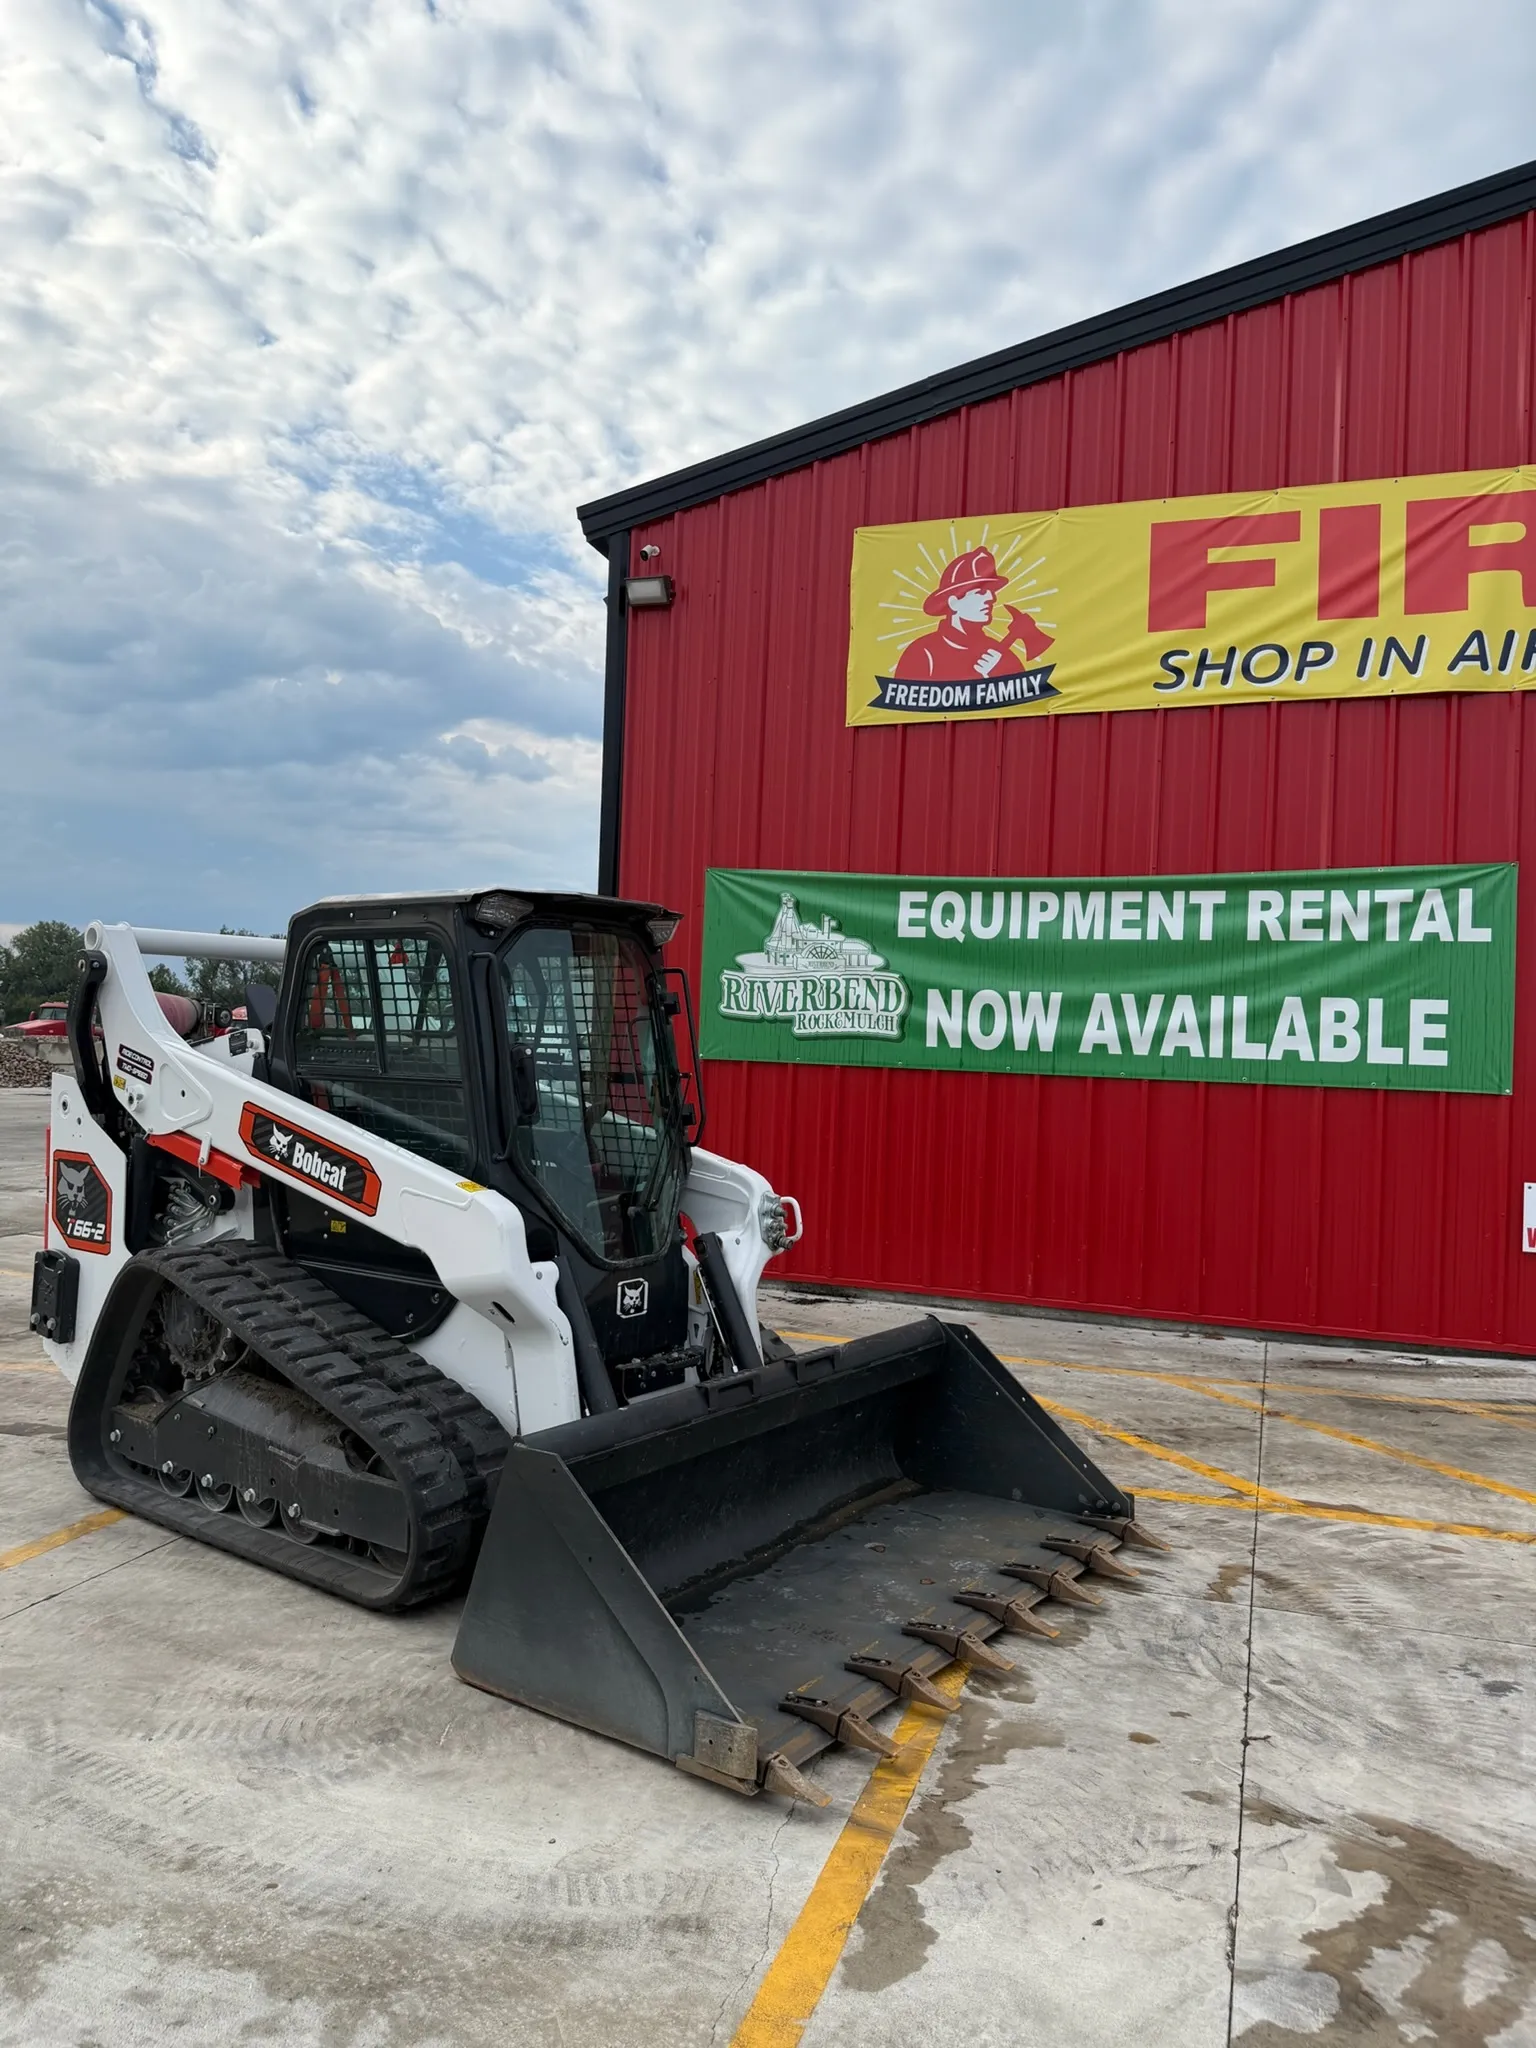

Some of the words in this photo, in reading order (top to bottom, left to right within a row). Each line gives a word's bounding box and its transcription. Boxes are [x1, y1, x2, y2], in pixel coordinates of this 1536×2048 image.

[1153, 640, 1336, 691] SHOP
[1356, 635, 1430, 680] IN
[884, 683, 970, 708] FREEDOM
[976, 673, 1042, 705] FAMILY
[898, 890, 1225, 941] EQUIPMENT
[1246, 888, 1493, 943] RENTAL
[723, 976, 903, 1013] RIVERBEND
[926, 988, 1061, 1053] NOW
[1079, 994, 1449, 1066] AVAILABLE
[292, 1141, 347, 1192] Bobcat
